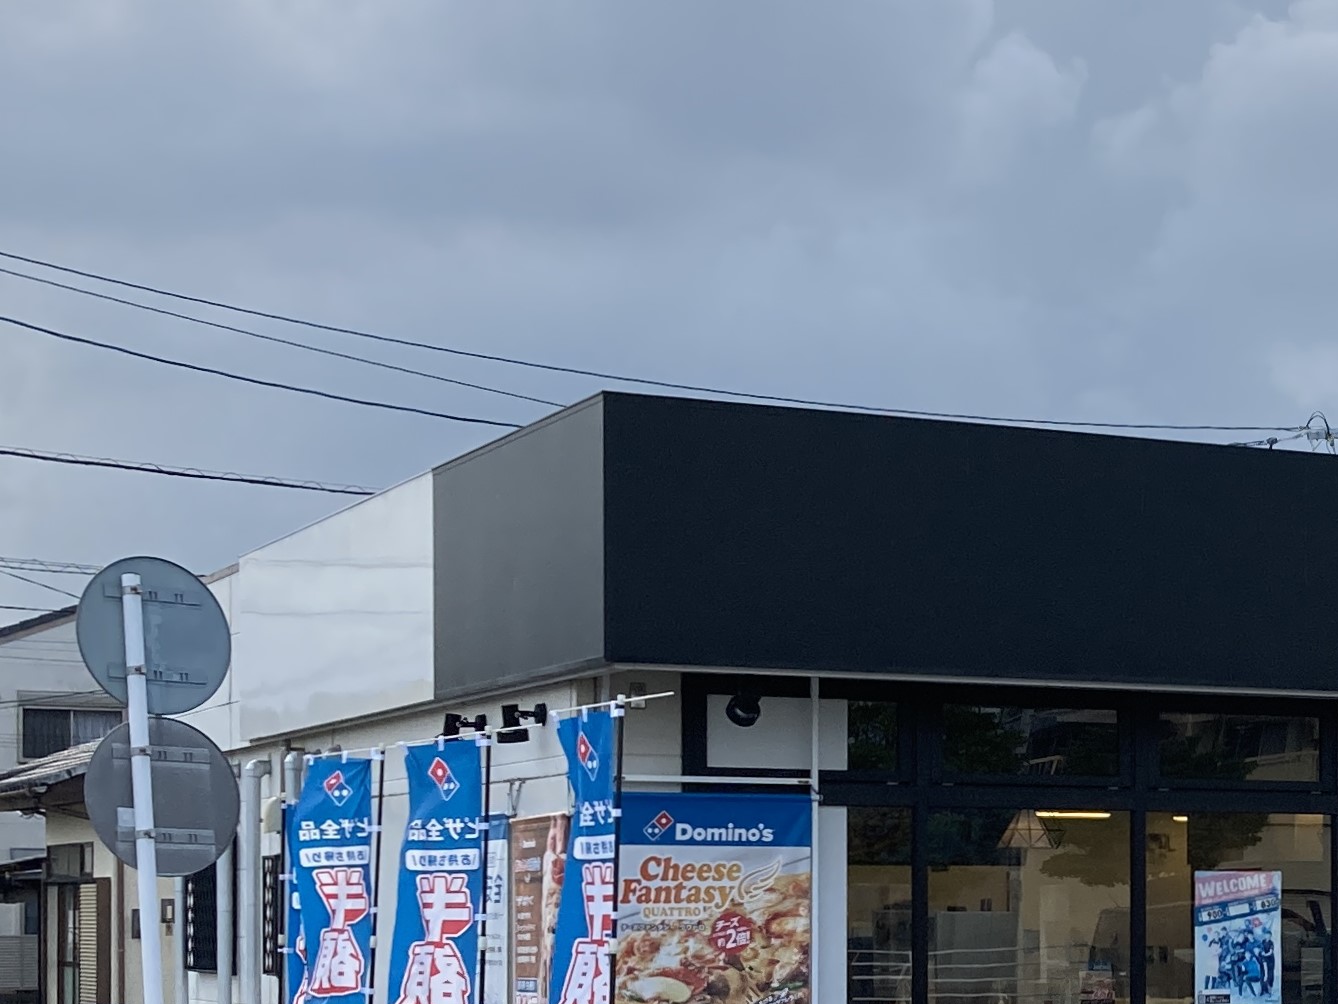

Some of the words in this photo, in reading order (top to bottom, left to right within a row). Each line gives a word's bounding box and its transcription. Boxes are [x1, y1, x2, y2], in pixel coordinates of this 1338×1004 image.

[675, 823, 774, 842] Domino's
[640, 856, 741, 881] Cheese
[620, 879, 735, 910] Fantasy
[1199, 873, 1266, 898] WELCOME
[643, 907, 701, 918] QUATTRO
[715, 916, 742, 932] チーズ
